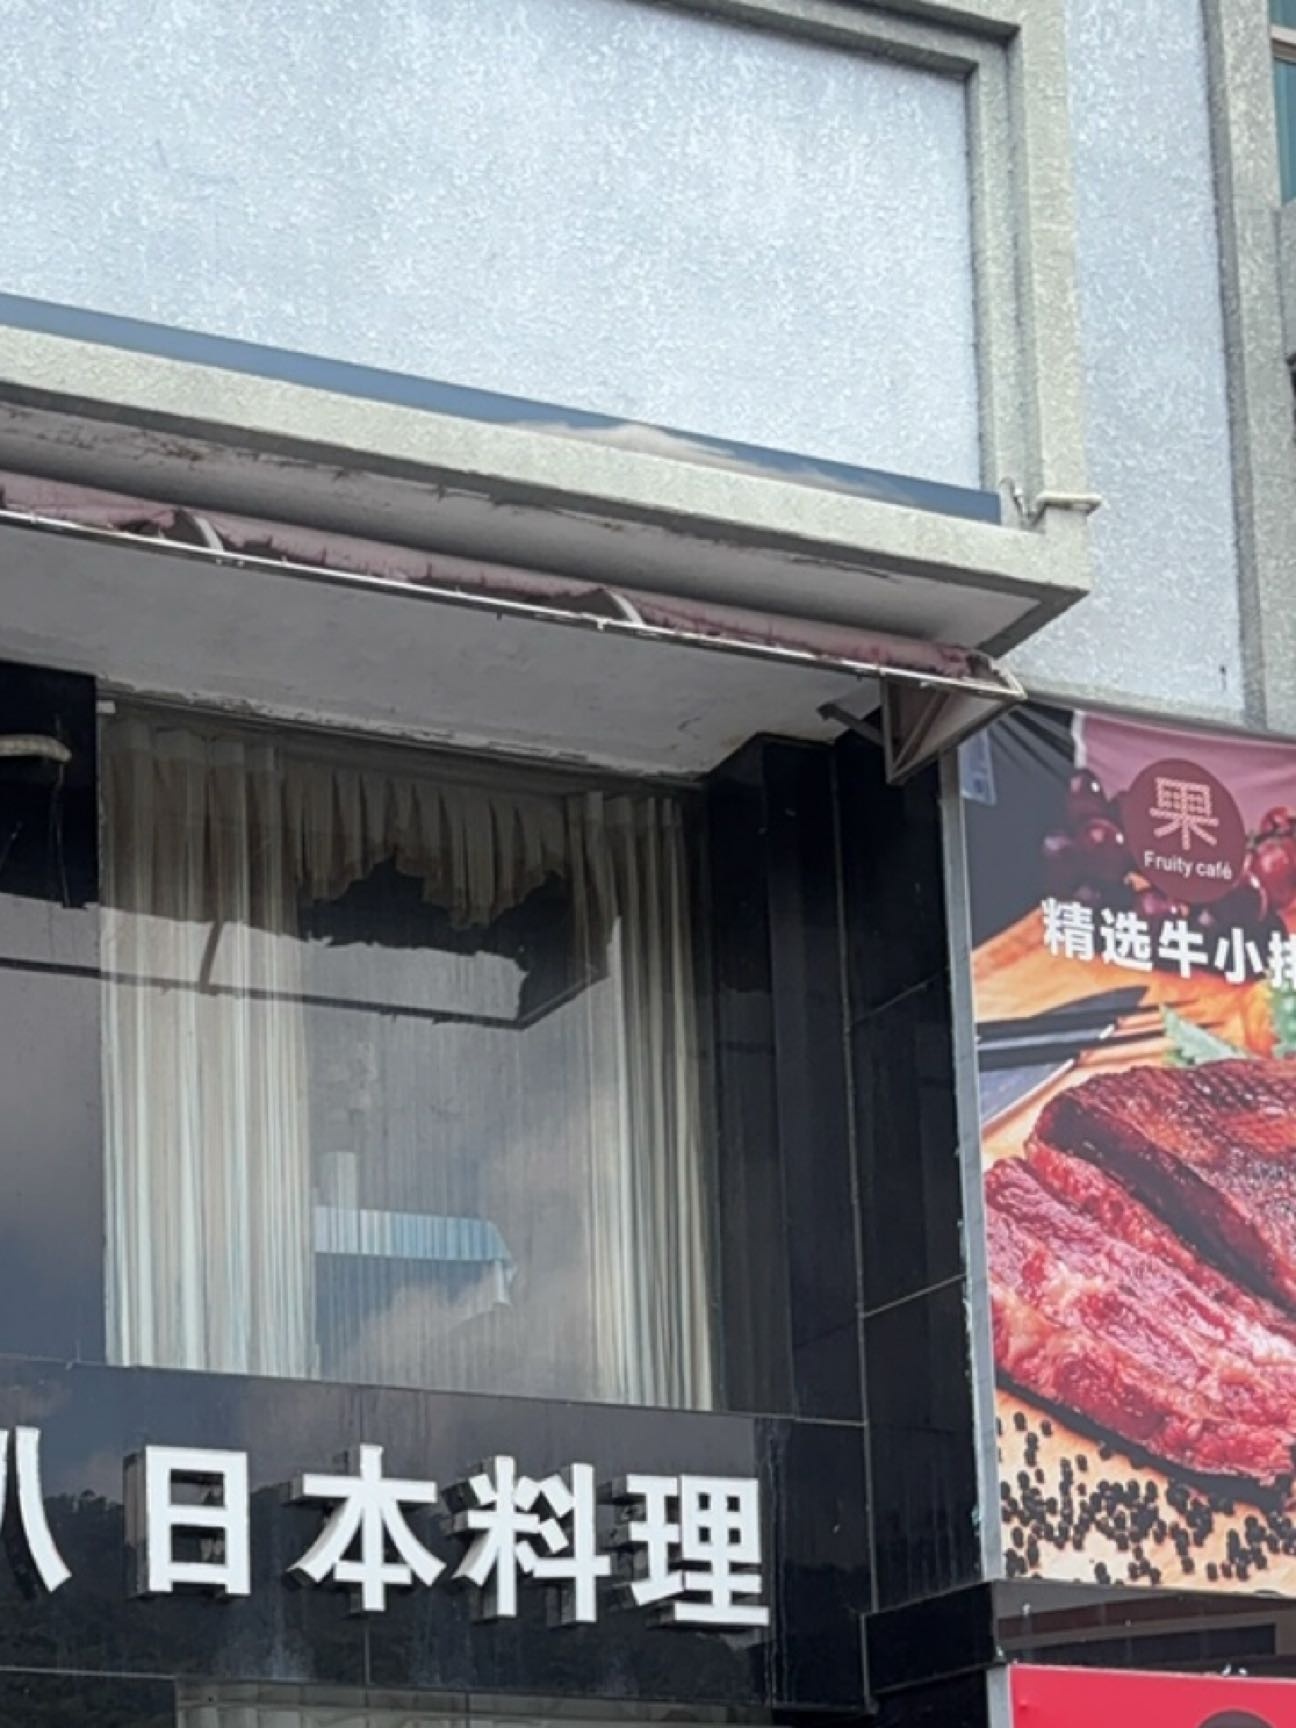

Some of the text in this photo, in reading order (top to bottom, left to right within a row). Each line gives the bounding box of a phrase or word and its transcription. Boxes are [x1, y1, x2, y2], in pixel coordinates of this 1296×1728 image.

[1149, 778, 1219, 850] 果
[1144, 850, 1193, 878] Fruity
[140, 1443, 771, 1627] 日本料理
